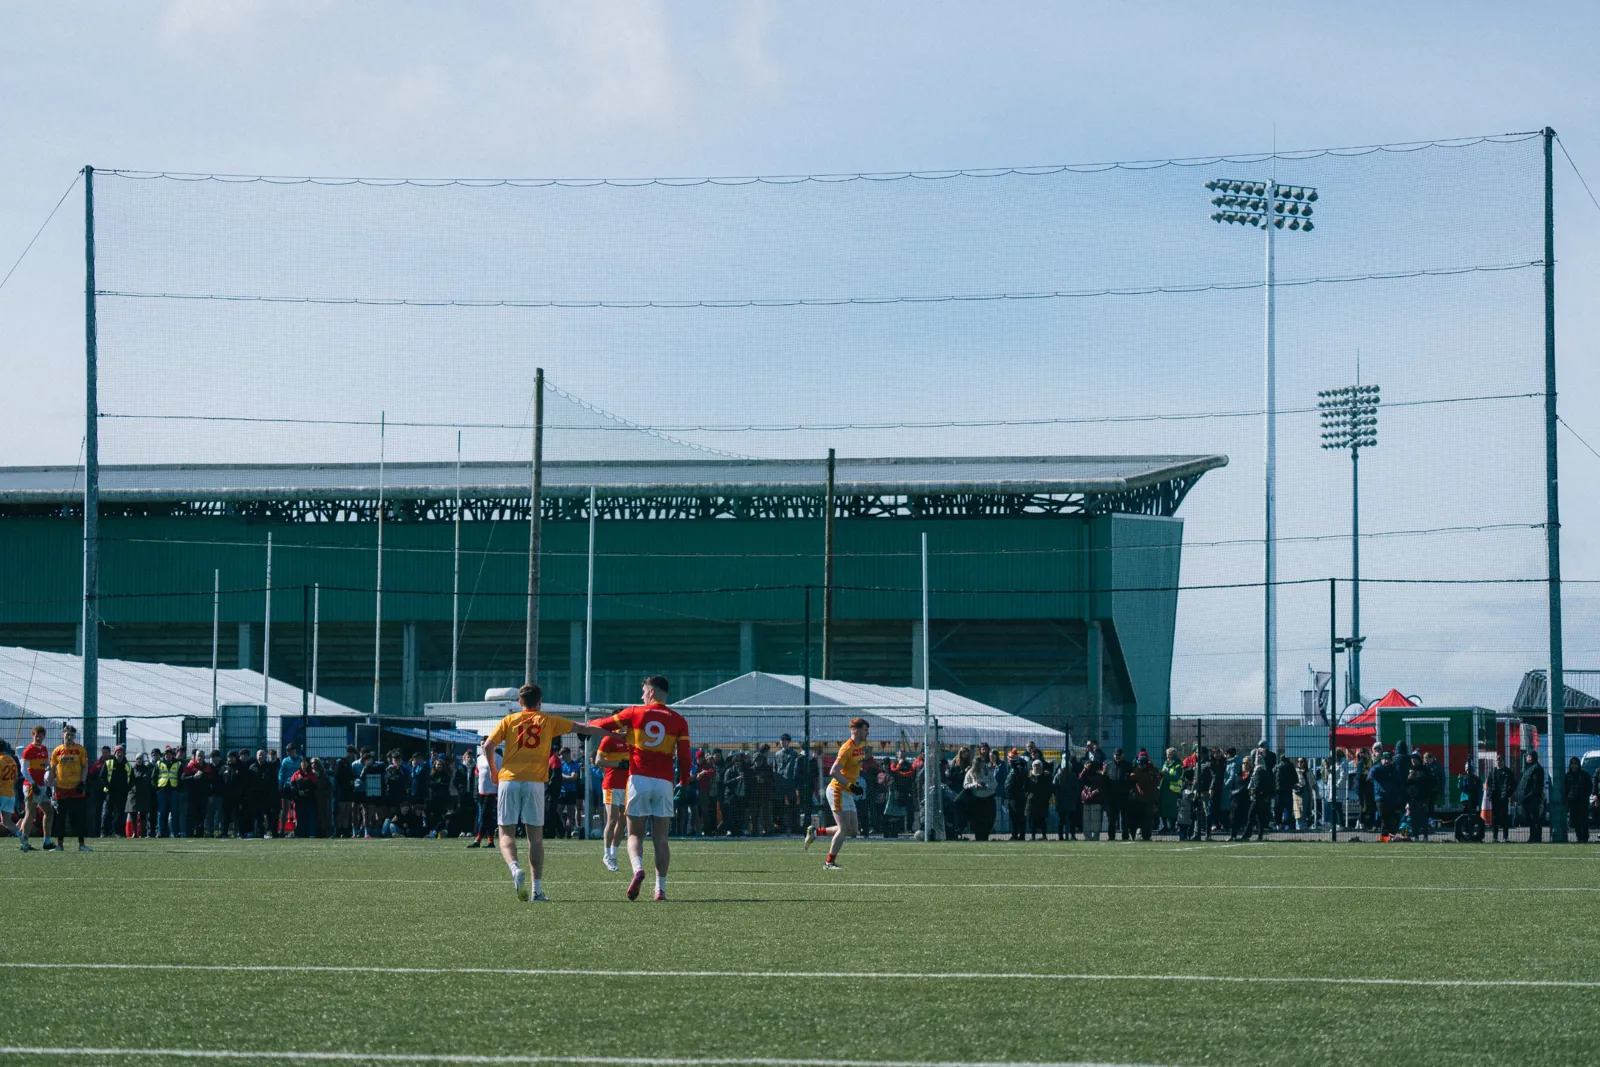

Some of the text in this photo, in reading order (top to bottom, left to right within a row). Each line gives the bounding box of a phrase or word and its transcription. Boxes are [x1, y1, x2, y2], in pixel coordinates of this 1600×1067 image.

[518, 724, 542, 749] 18
[644, 721, 666, 747] 9
[2, 764, 17, 781] 28
